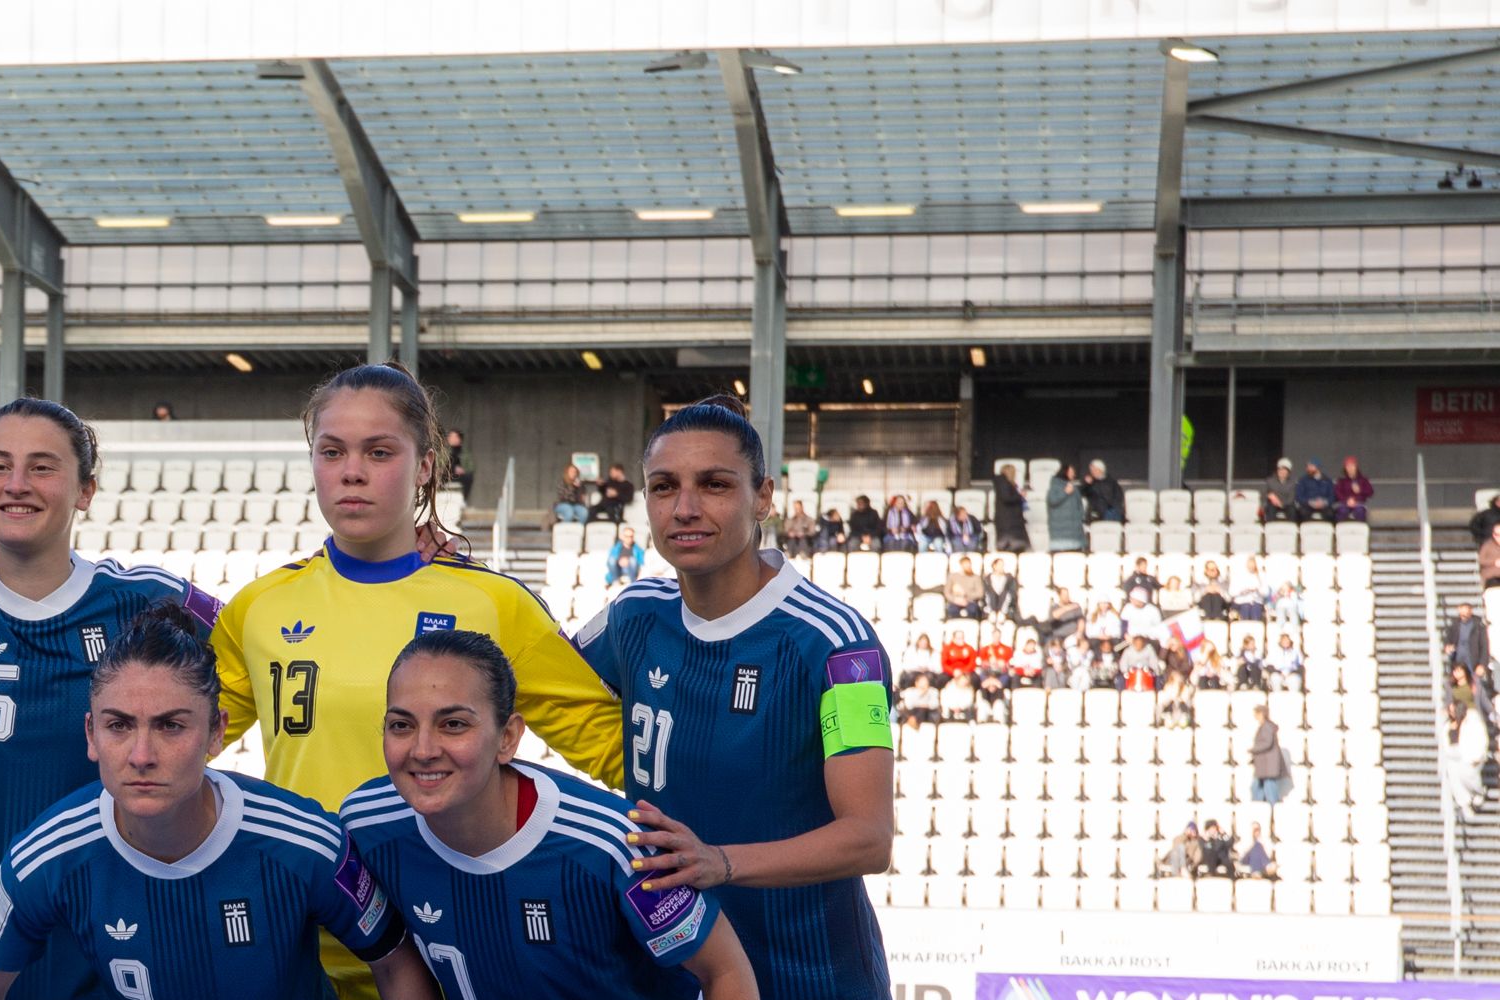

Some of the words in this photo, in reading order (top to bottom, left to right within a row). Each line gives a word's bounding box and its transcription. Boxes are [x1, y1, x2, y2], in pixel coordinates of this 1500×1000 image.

[1431, 391, 1494, 413] BETRI
[269, 659, 321, 738] 13
[631, 702, 674, 792] 21
[649, 886, 688, 920] EUROPEAN
[651, 890, 692, 926] QUALIFIERS
[888, 950, 977, 965] KKAFROST
[1060, 955, 1171, 968] BAKKAFROST
[1255, 959, 1371, 974] BAKKAFROST
